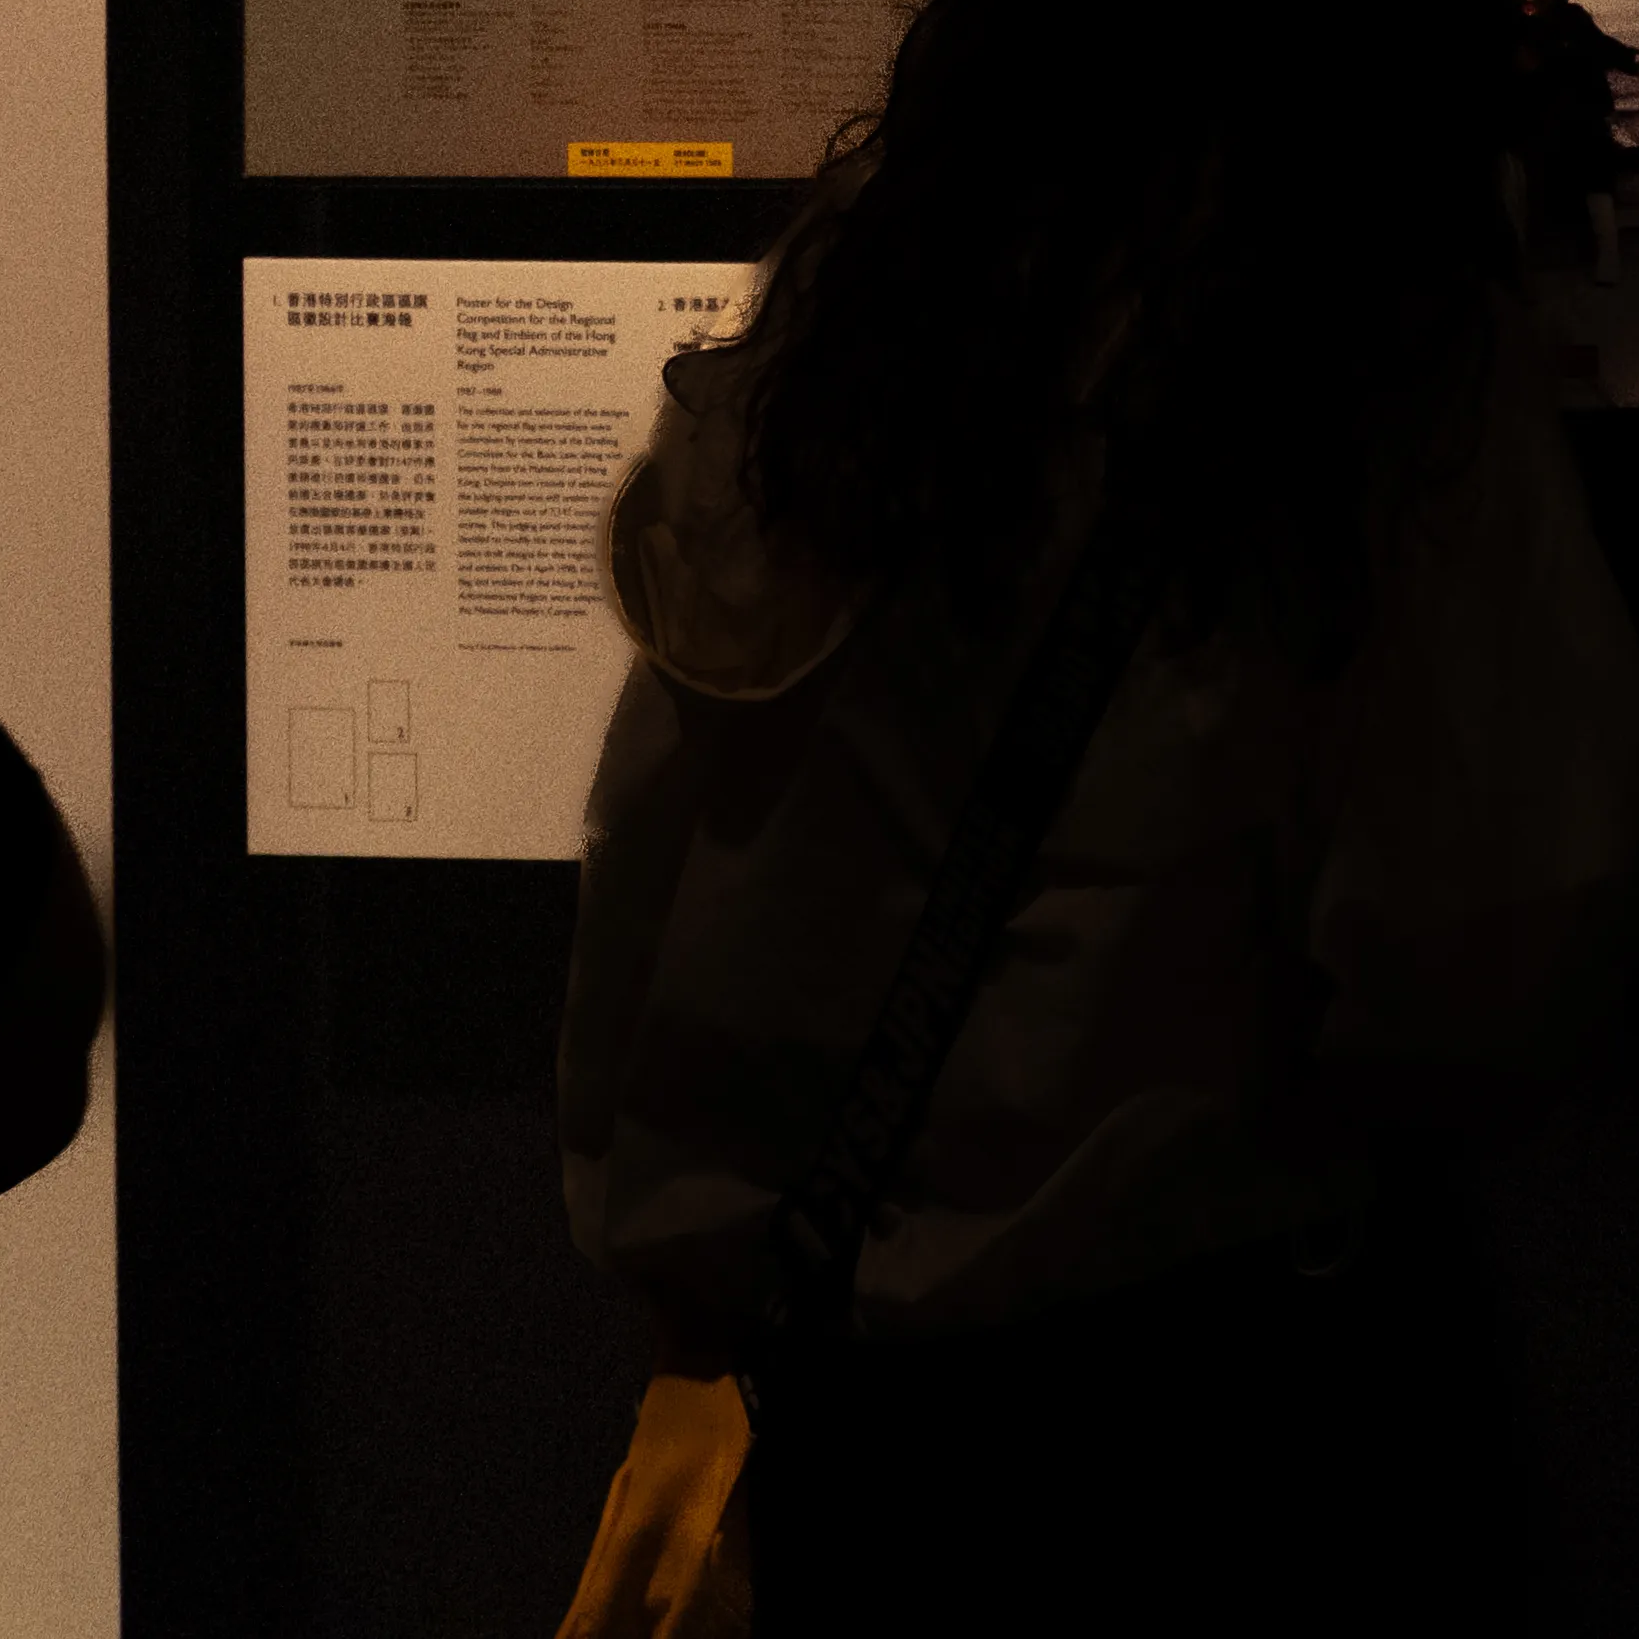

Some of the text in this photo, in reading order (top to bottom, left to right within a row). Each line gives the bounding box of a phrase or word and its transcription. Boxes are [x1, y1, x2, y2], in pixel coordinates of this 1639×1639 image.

[456, 297, 573, 311] Poster for the Design
[457, 313, 615, 327] Competition for the Regional
[457, 329, 616, 344] Flag and Emblem of the Hong
[457, 345, 608, 357] Kong Special Administrative
[457, 360, 494, 372] Region
[396, 727, 405, 739] 2
